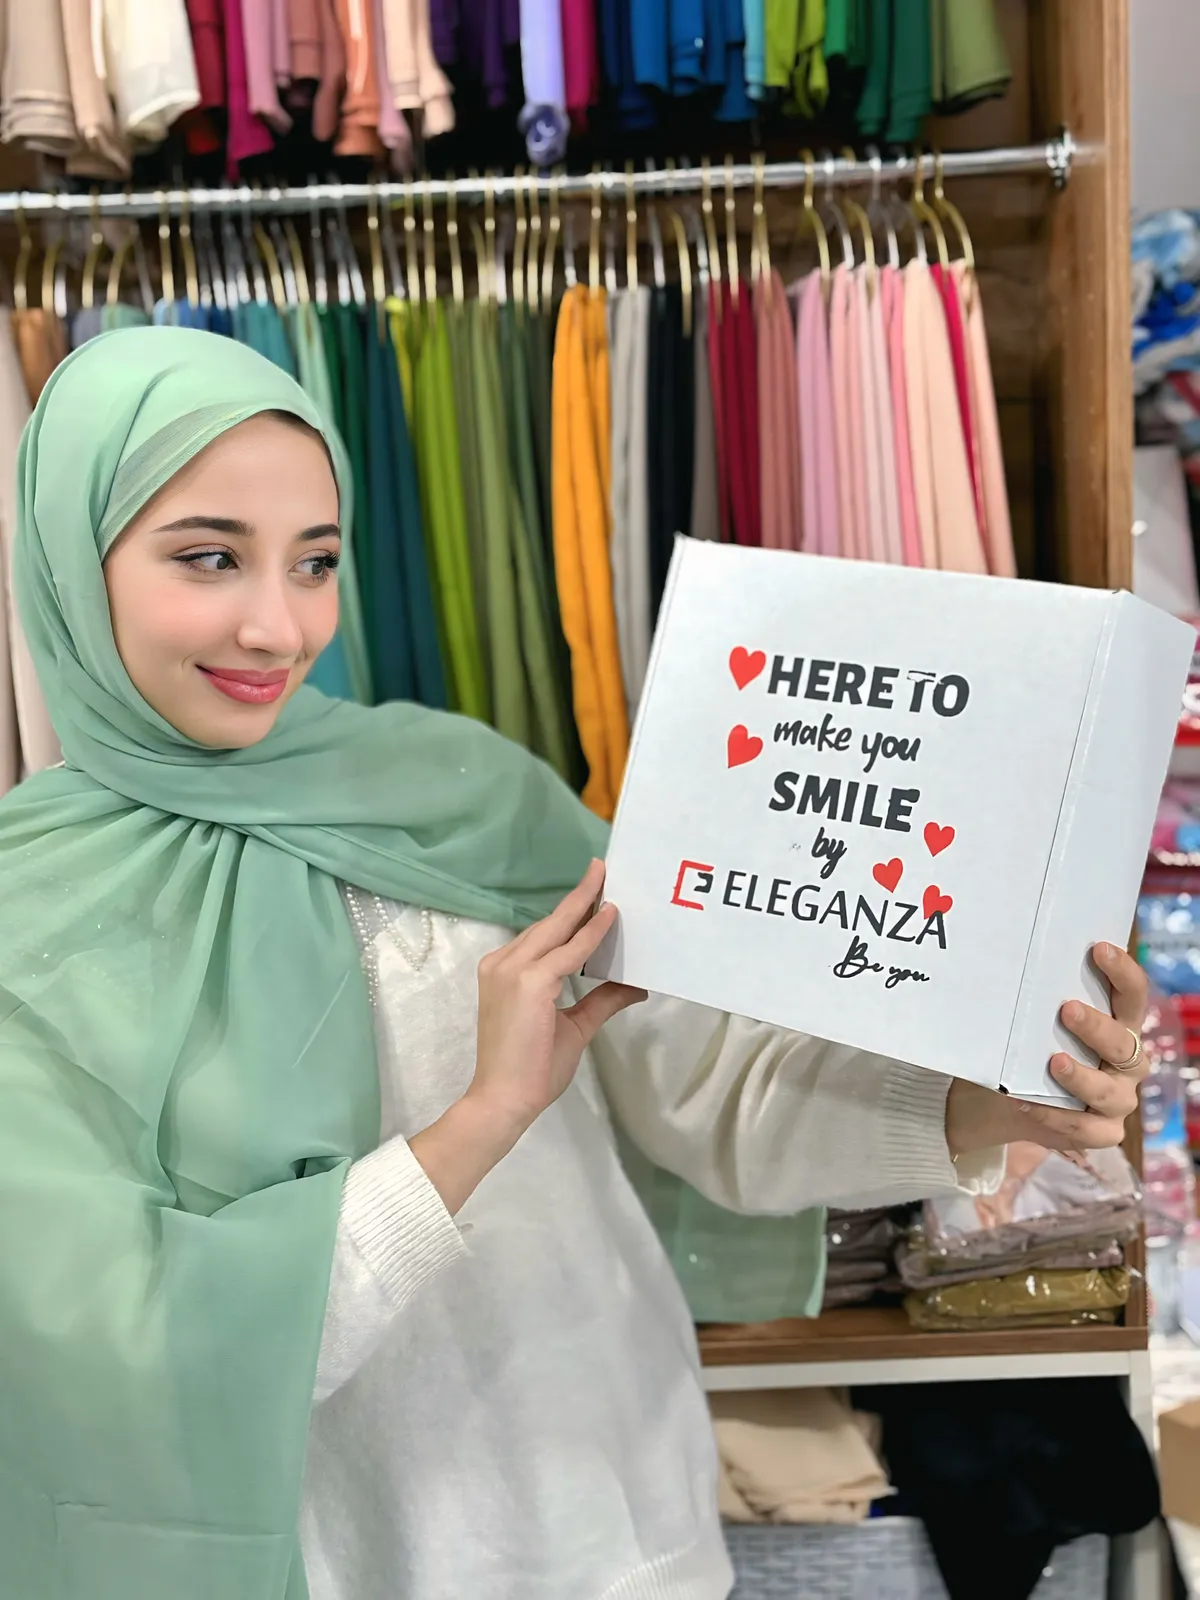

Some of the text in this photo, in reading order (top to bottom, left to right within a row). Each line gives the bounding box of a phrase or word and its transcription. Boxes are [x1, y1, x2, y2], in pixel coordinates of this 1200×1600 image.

[767, 655, 970, 718] HERE TO
[773, 713, 921, 773] make you
[768, 771, 921, 833] SMILE
[811, 827, 847, 879] by
[722, 870, 947, 949] ELEGANZA
[833, 935, 930, 988] Be you
